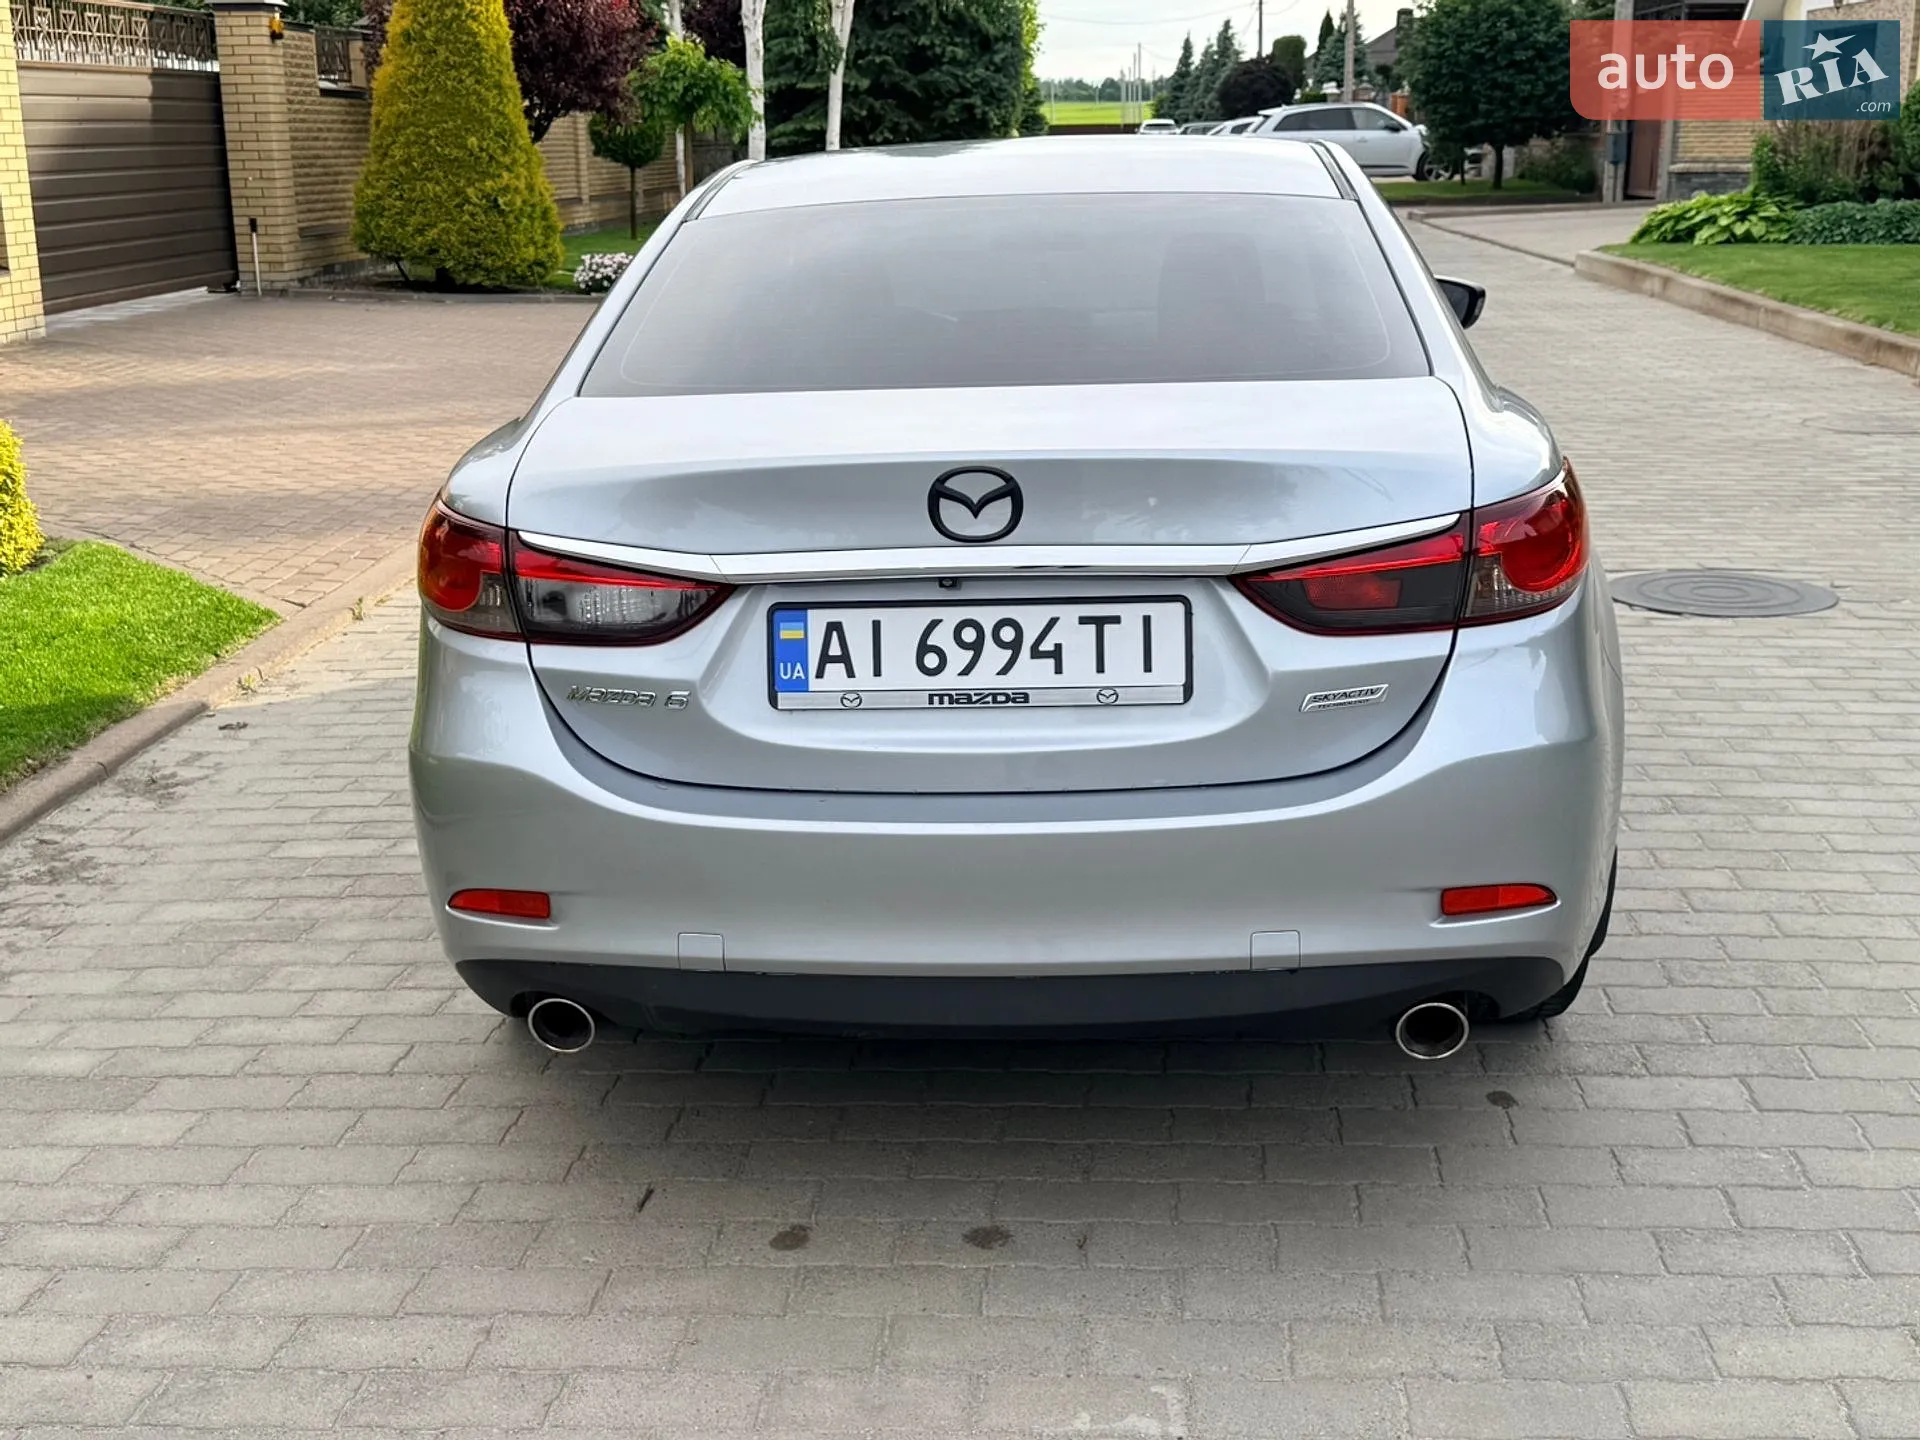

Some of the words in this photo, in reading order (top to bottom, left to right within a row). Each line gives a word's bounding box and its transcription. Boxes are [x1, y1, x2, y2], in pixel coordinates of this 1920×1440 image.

[780, 662, 805, 680] UA
[664, 690, 691, 710] 6
[1312, 688, 1379, 702] SKYACTIV
